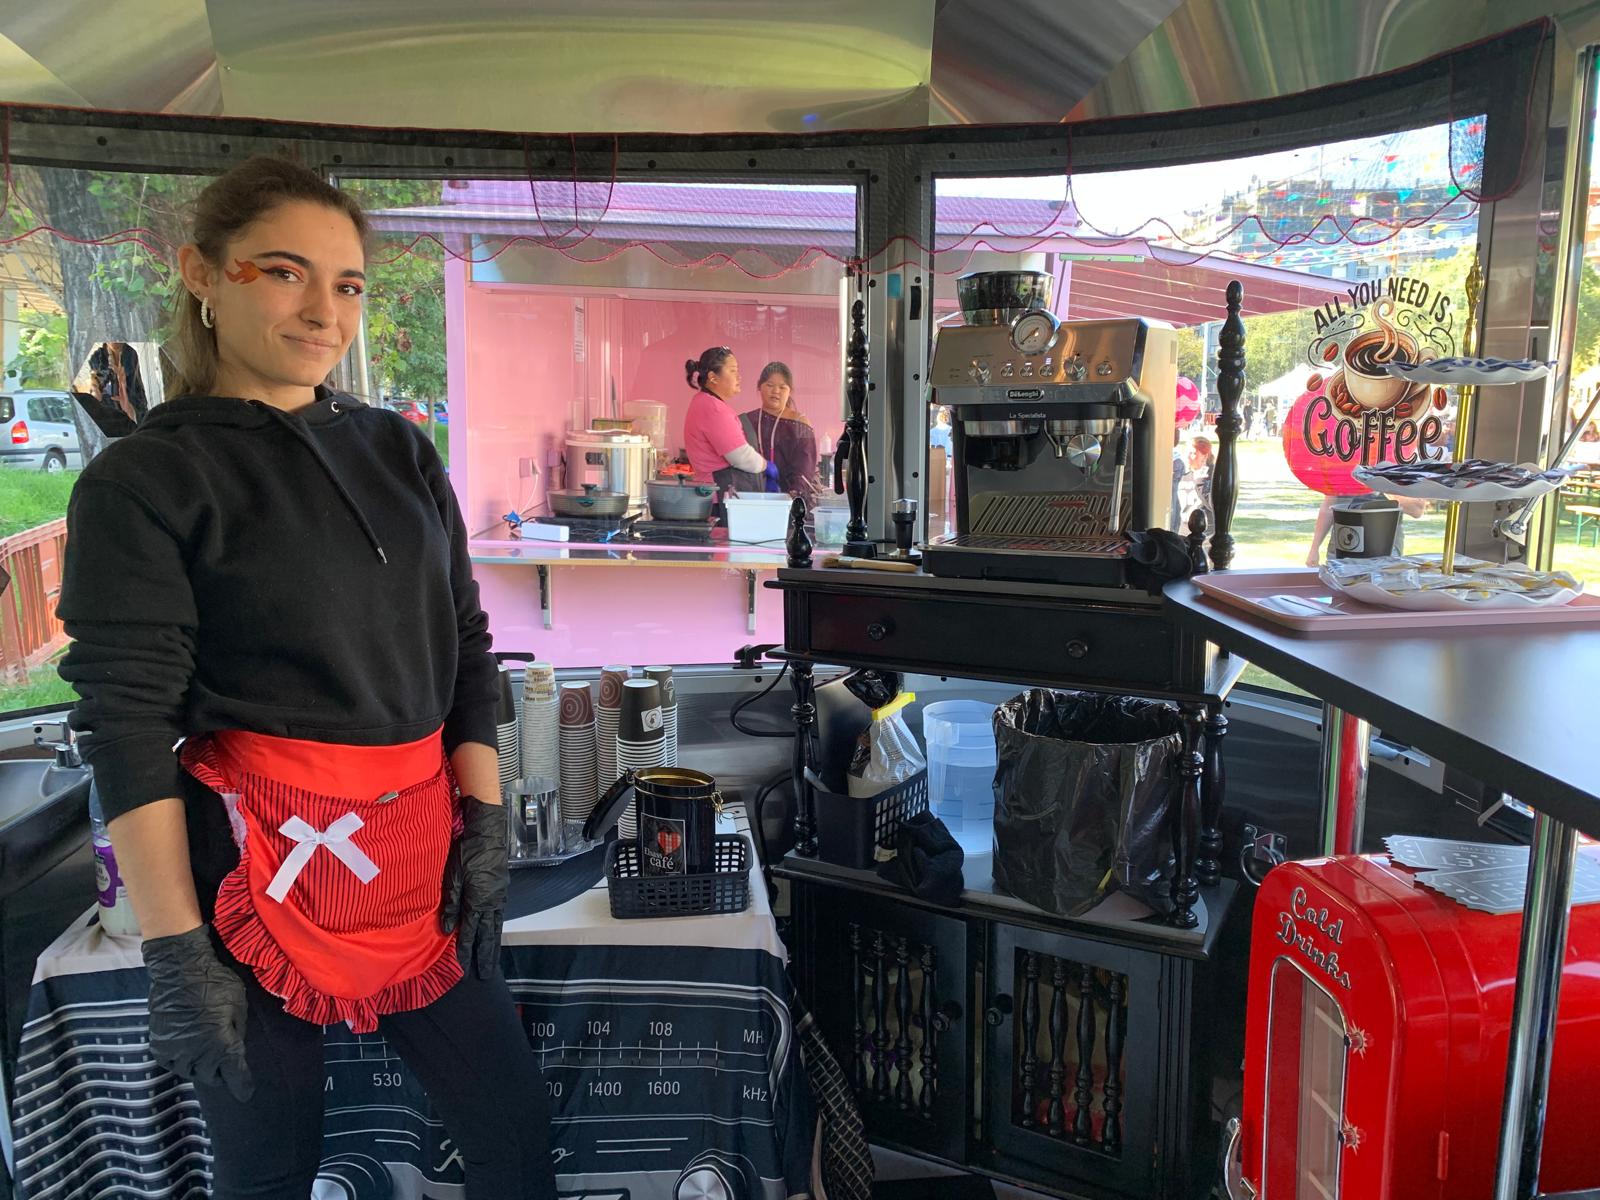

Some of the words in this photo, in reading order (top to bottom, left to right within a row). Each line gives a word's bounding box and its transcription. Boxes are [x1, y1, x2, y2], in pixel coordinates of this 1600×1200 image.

[1313, 295, 1346, 334] ALL
[1347, 278, 1382, 310] YOU
[1387, 277, 1430, 308] NEED
[1429, 291, 1451, 323] IS
[650, 856, 674, 870] café
[1291, 886, 1345, 945] Cold
[1276, 911, 1352, 990] Drinks
[531, 1022, 555, 1037] 100
[587, 1020, 611, 1036] 104
[649, 1021, 673, 1037] 108
[743, 1028, 764, 1045] MH
[373, 1072, 402, 1087] 530
[588, 1081, 622, 1097] 1400
[647, 1080, 681, 1096] 1600
[743, 1084, 768, 1102] kHz
